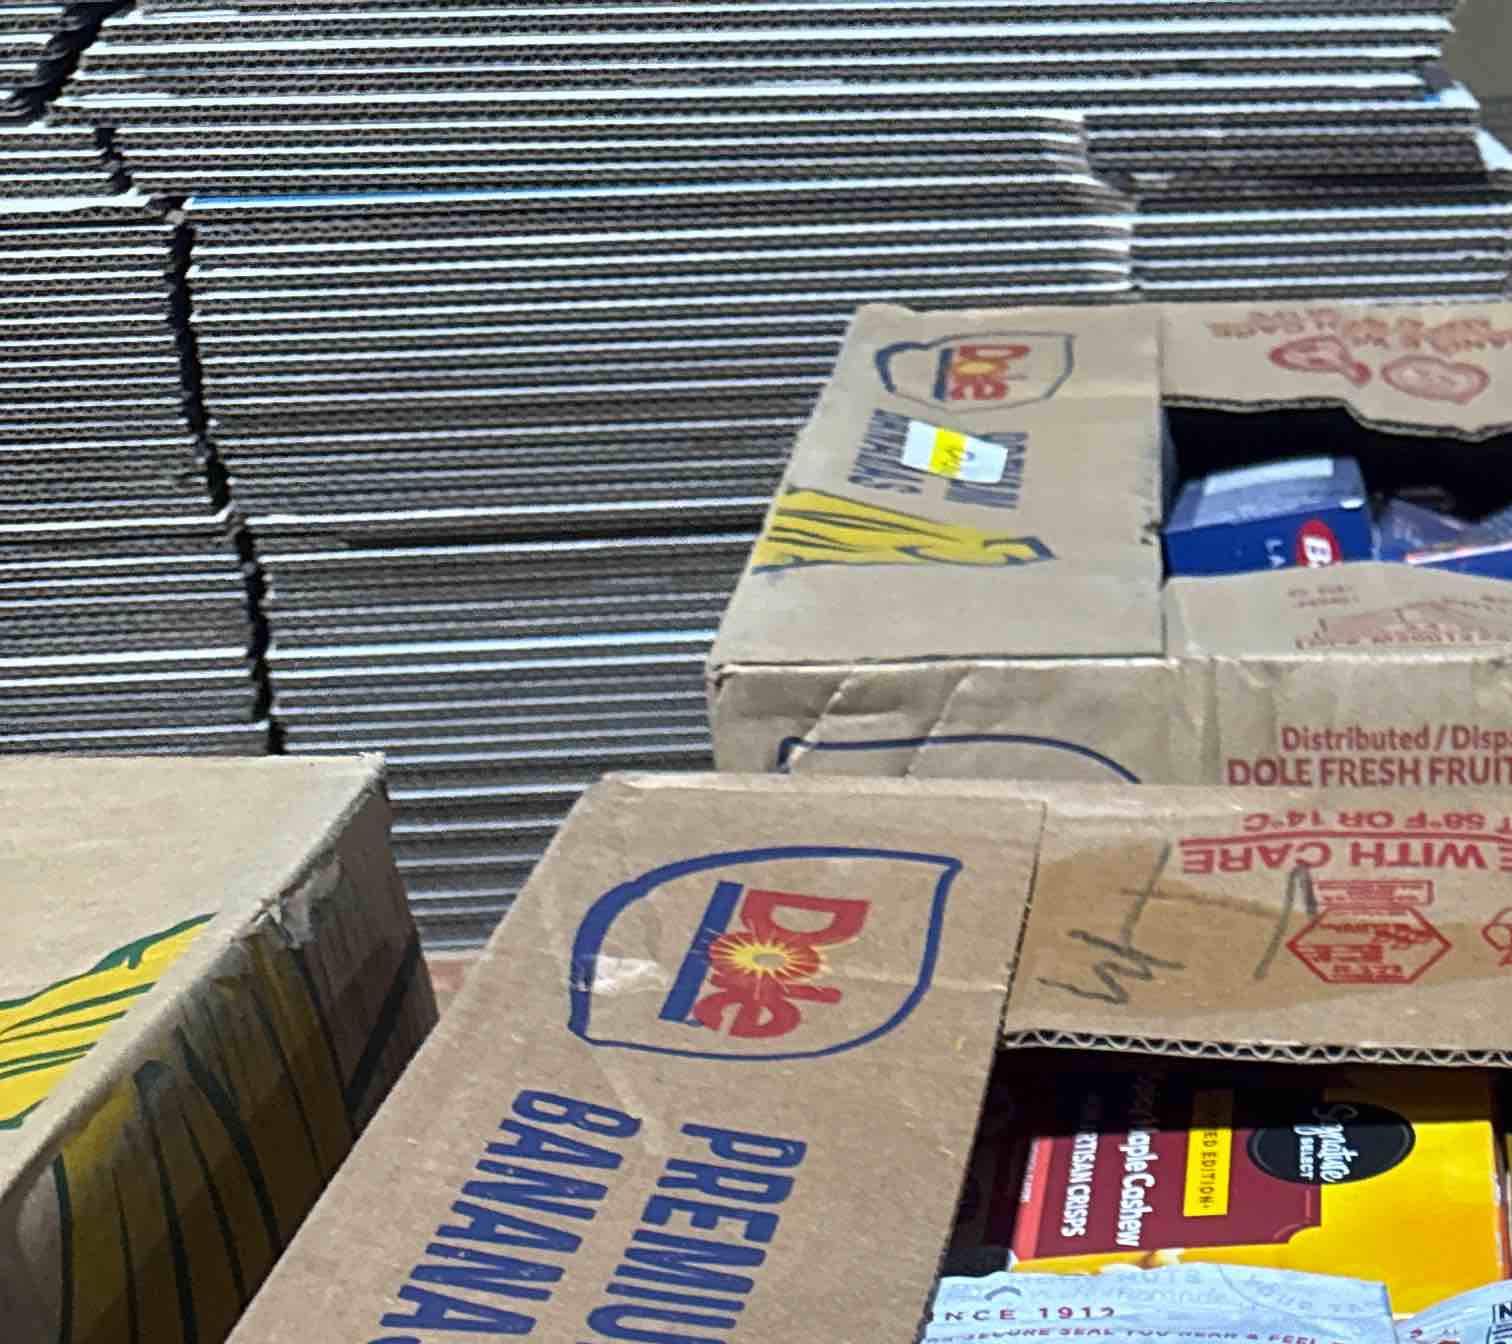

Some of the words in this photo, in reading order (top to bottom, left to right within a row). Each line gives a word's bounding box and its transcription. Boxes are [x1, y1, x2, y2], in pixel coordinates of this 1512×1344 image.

[1282, 725, 1430, 752] Distributed
[1227, 758, 1313, 787] DOLE
[1319, 757, 1422, 787] FRESH
[1338, 810, 1394, 830] OR
[1182, 841, 1331, 876] CARE
[1350, 841, 1488, 871] WITH
[692, 887, 871, 1039] Dole
[1059, 1183, 1092, 1237] CRISPS
[1115, 1172, 1155, 1248] Cashew
[928, 1307, 1018, 1321] INCE
